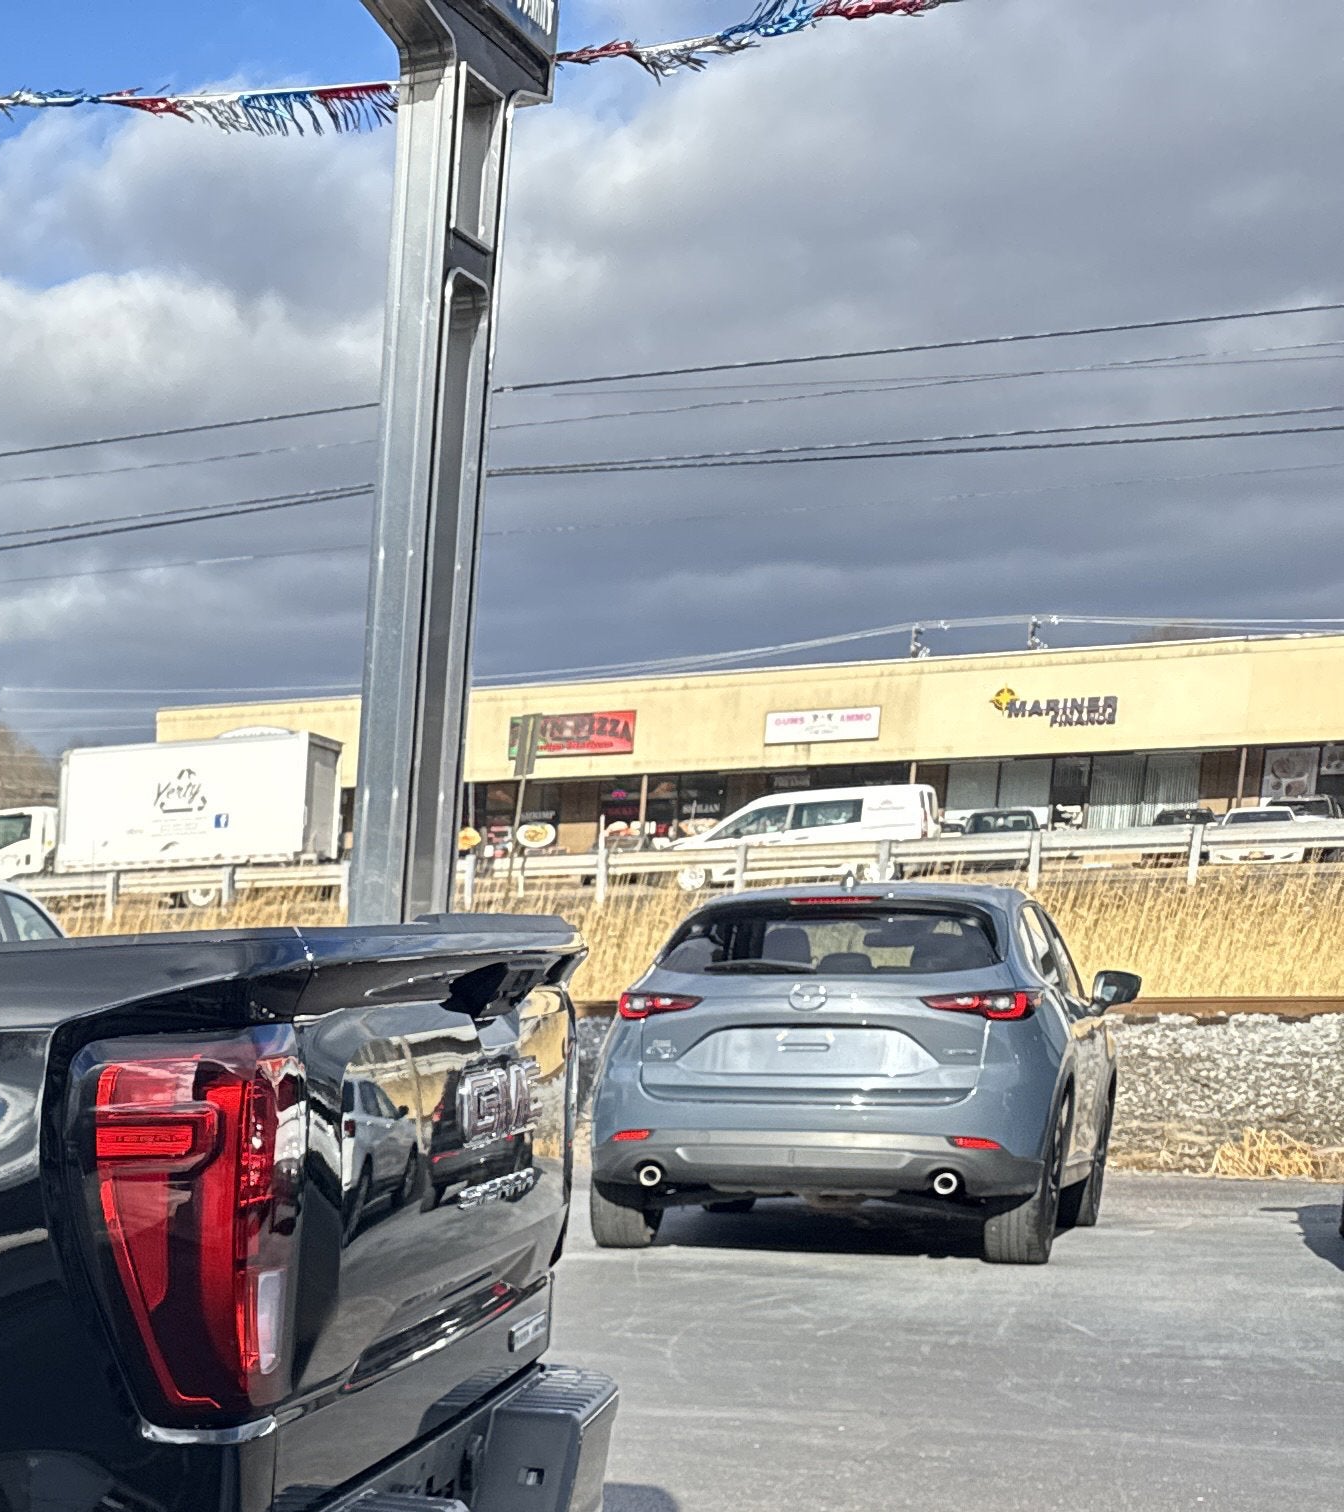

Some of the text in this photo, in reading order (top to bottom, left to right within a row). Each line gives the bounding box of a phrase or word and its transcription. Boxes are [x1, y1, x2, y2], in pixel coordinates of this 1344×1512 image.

[774, 712, 872, 726] GUNS AMMO
[1007, 695, 1118, 728] MARINER FINANCE
